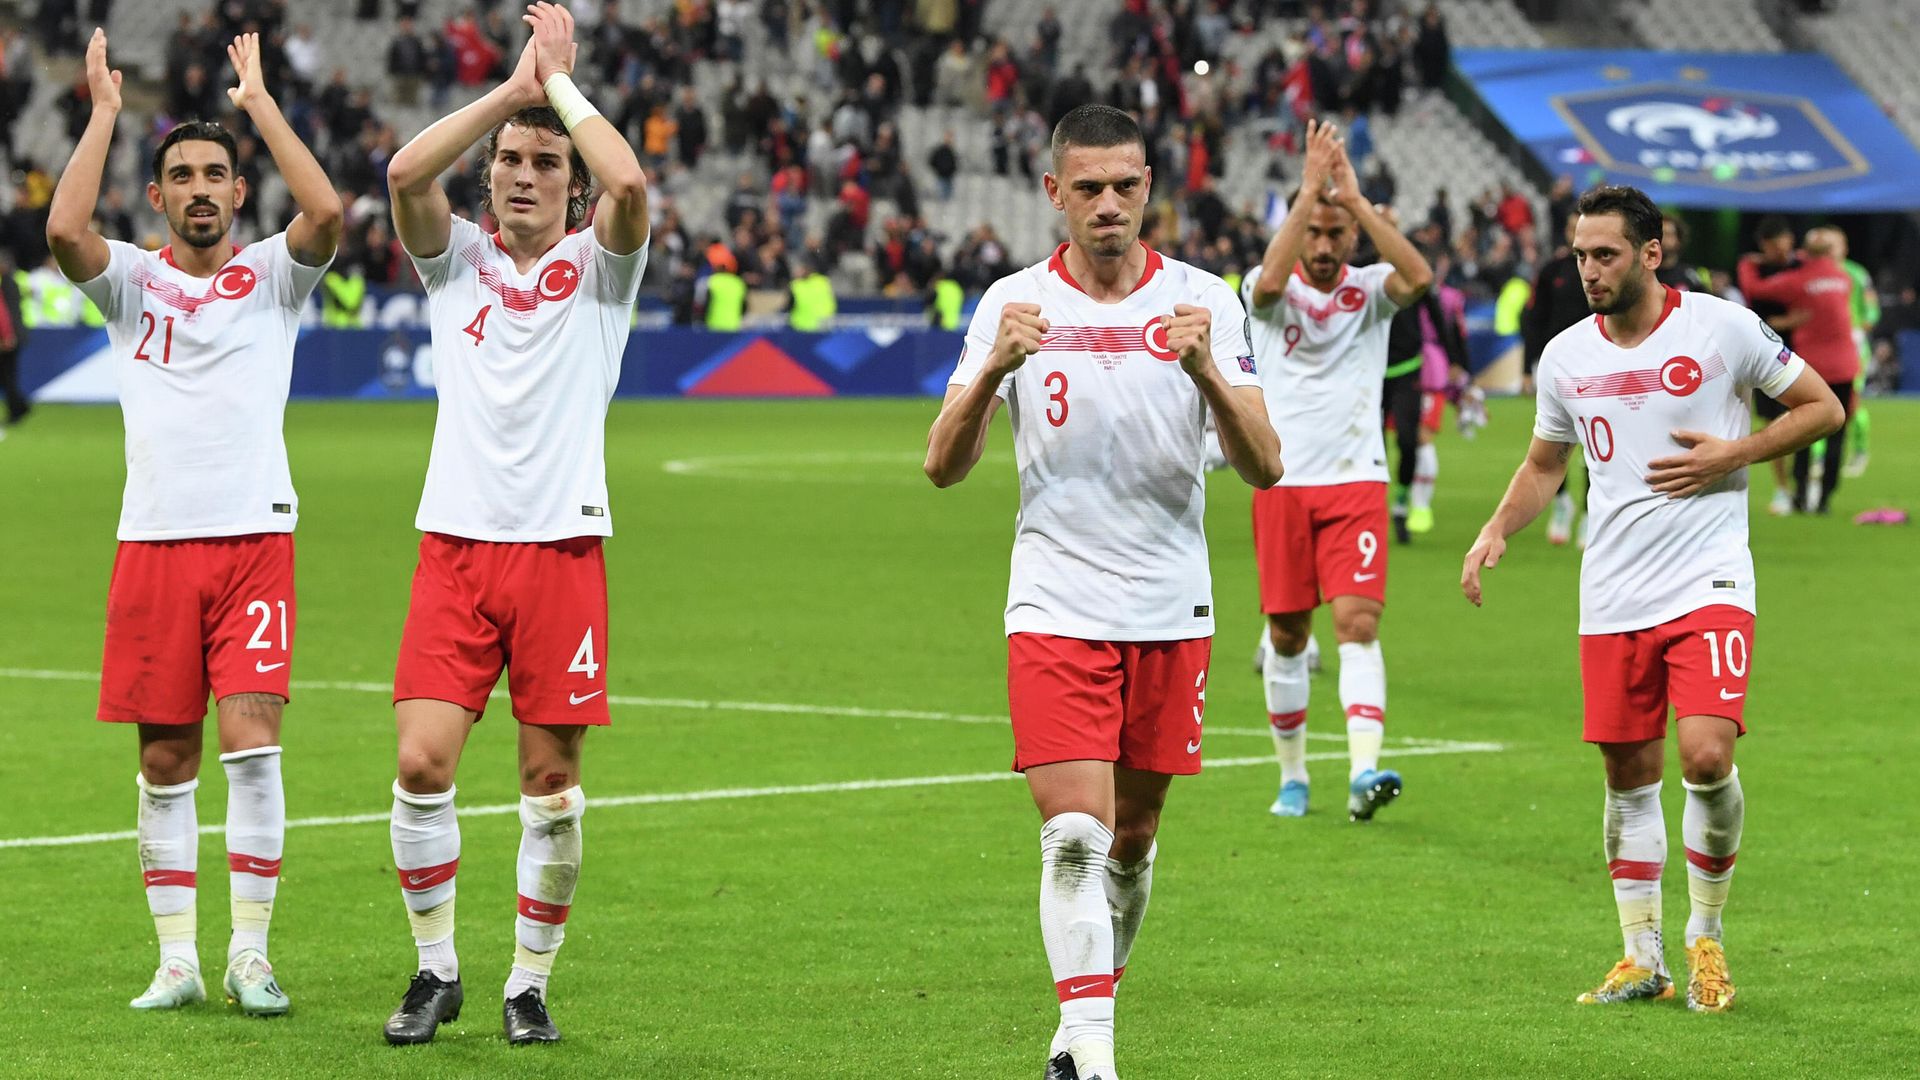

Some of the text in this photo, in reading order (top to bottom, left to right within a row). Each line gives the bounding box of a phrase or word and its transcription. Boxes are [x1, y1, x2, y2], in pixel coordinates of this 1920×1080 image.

[134, 311, 174, 364] 21
[462, 304, 492, 347] 4
[1284, 325, 1300, 357] 9
[1045, 370, 1069, 428] 3
[1578, 416, 1614, 462] 10
[1357, 530, 1378, 569] 9
[245, 600, 288, 651] 21
[567, 625, 600, 679] 4
[1703, 629, 1747, 678] 10
[1193, 669, 1205, 725] 3
